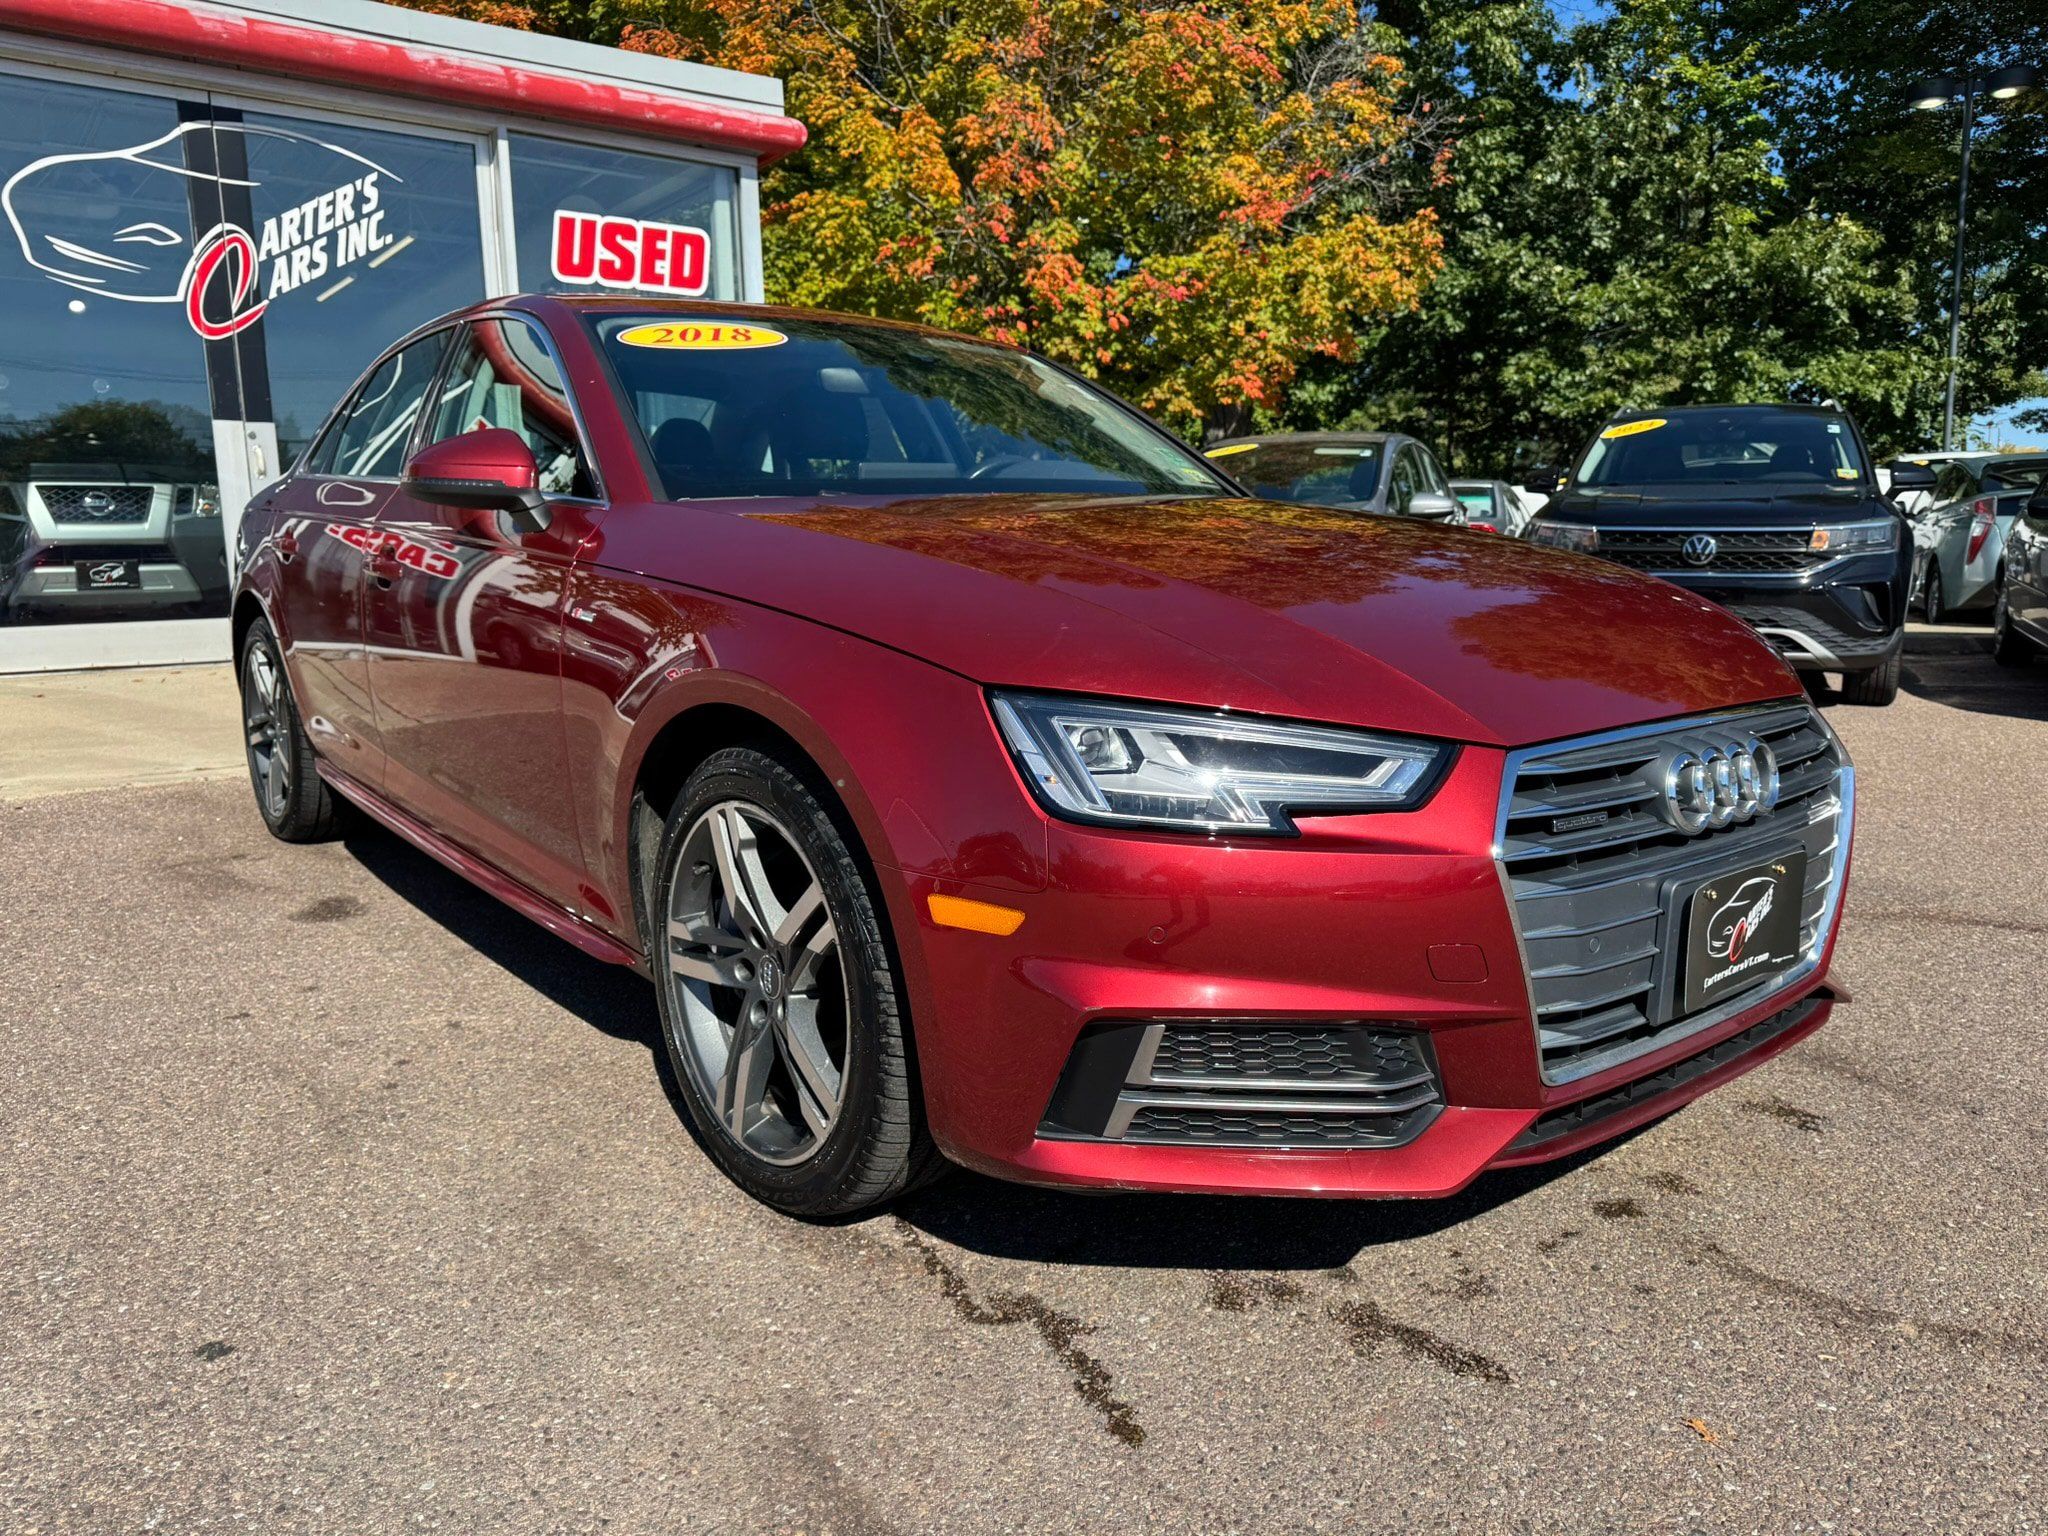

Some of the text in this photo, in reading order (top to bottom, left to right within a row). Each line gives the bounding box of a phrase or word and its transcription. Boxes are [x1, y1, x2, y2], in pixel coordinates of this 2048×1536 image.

[336, 210, 393, 268] INC.
[554, 213, 707, 292] USED
[651, 327, 752, 344] 2018
